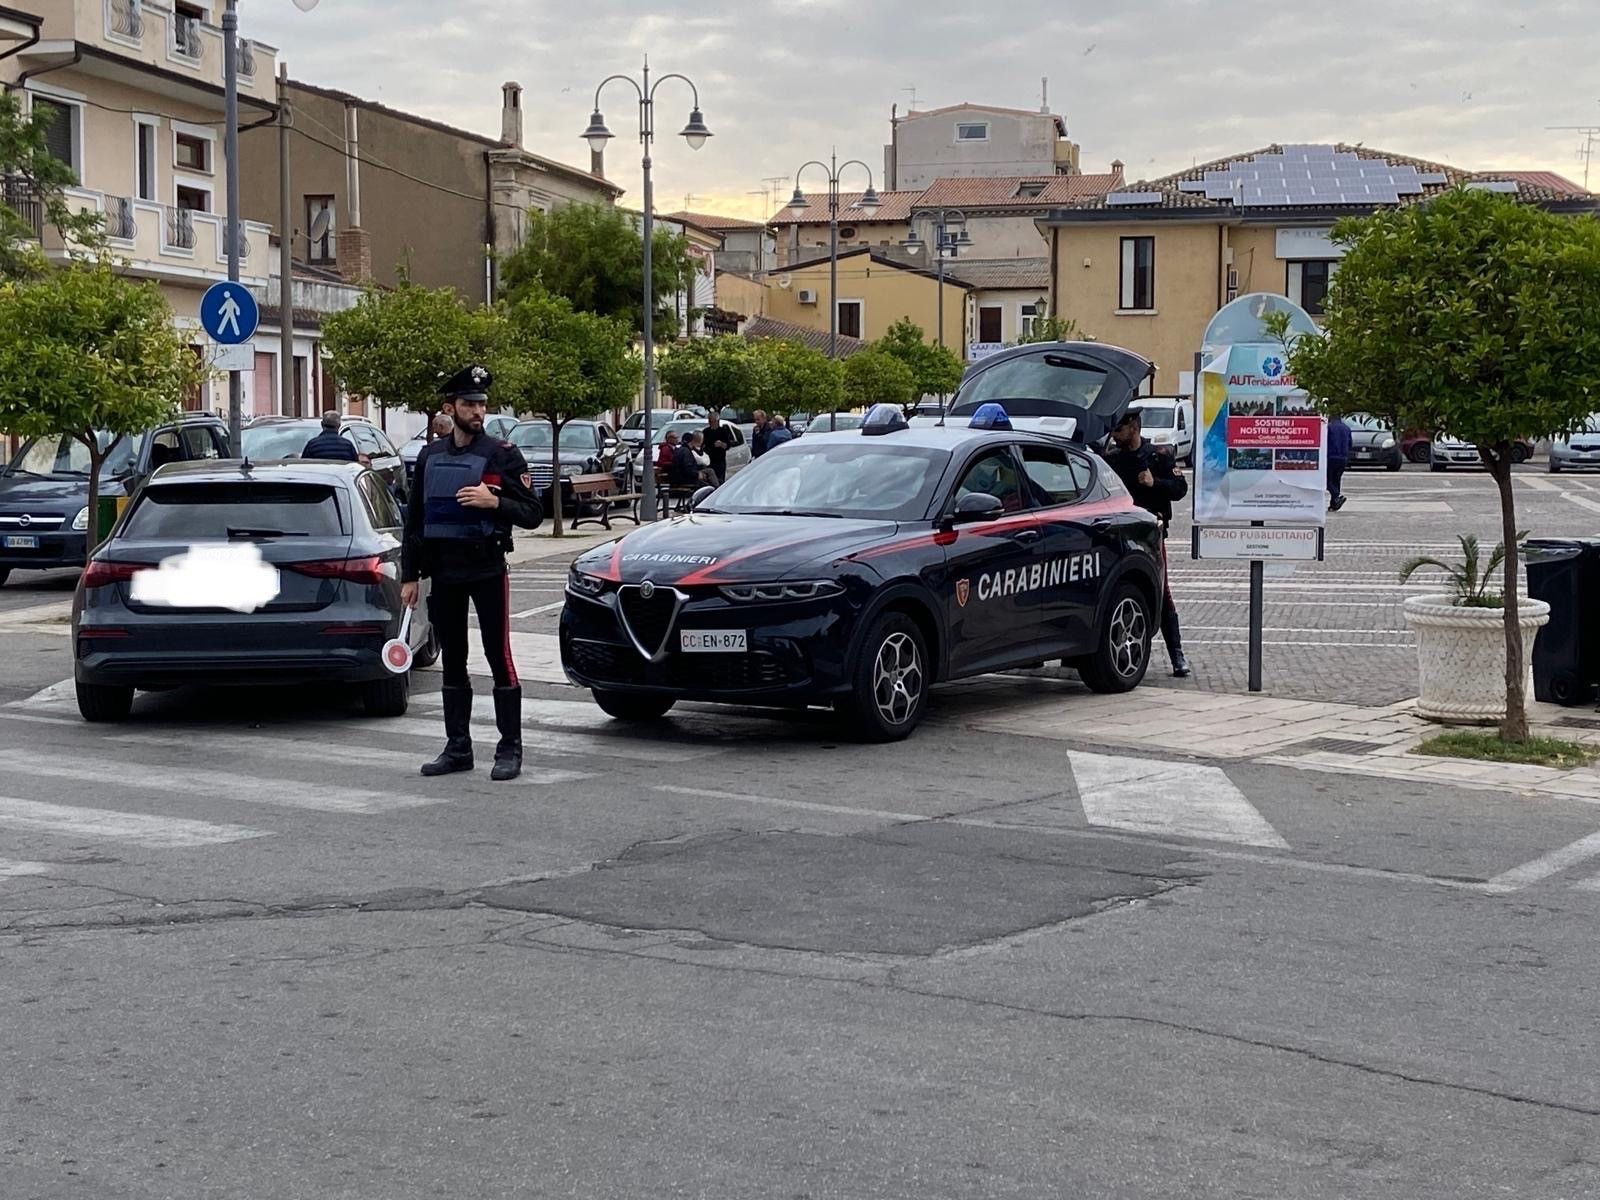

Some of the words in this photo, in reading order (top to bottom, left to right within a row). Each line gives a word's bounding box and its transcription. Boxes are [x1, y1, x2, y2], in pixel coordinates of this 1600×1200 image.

[1254, 419, 1290, 427] SOSTIENI
[1240, 427, 1268, 435] NOSTRI
[1270, 427, 1309, 435] PROGETTI
[1202, 530, 1237, 539] SPAZIO
[1240, 531, 1314, 541] PUBBLICITARIO
[622, 553, 718, 565] CARABINIERI
[978, 552, 1101, 601] CARABINIERI
[682, 634, 697, 648] CC
